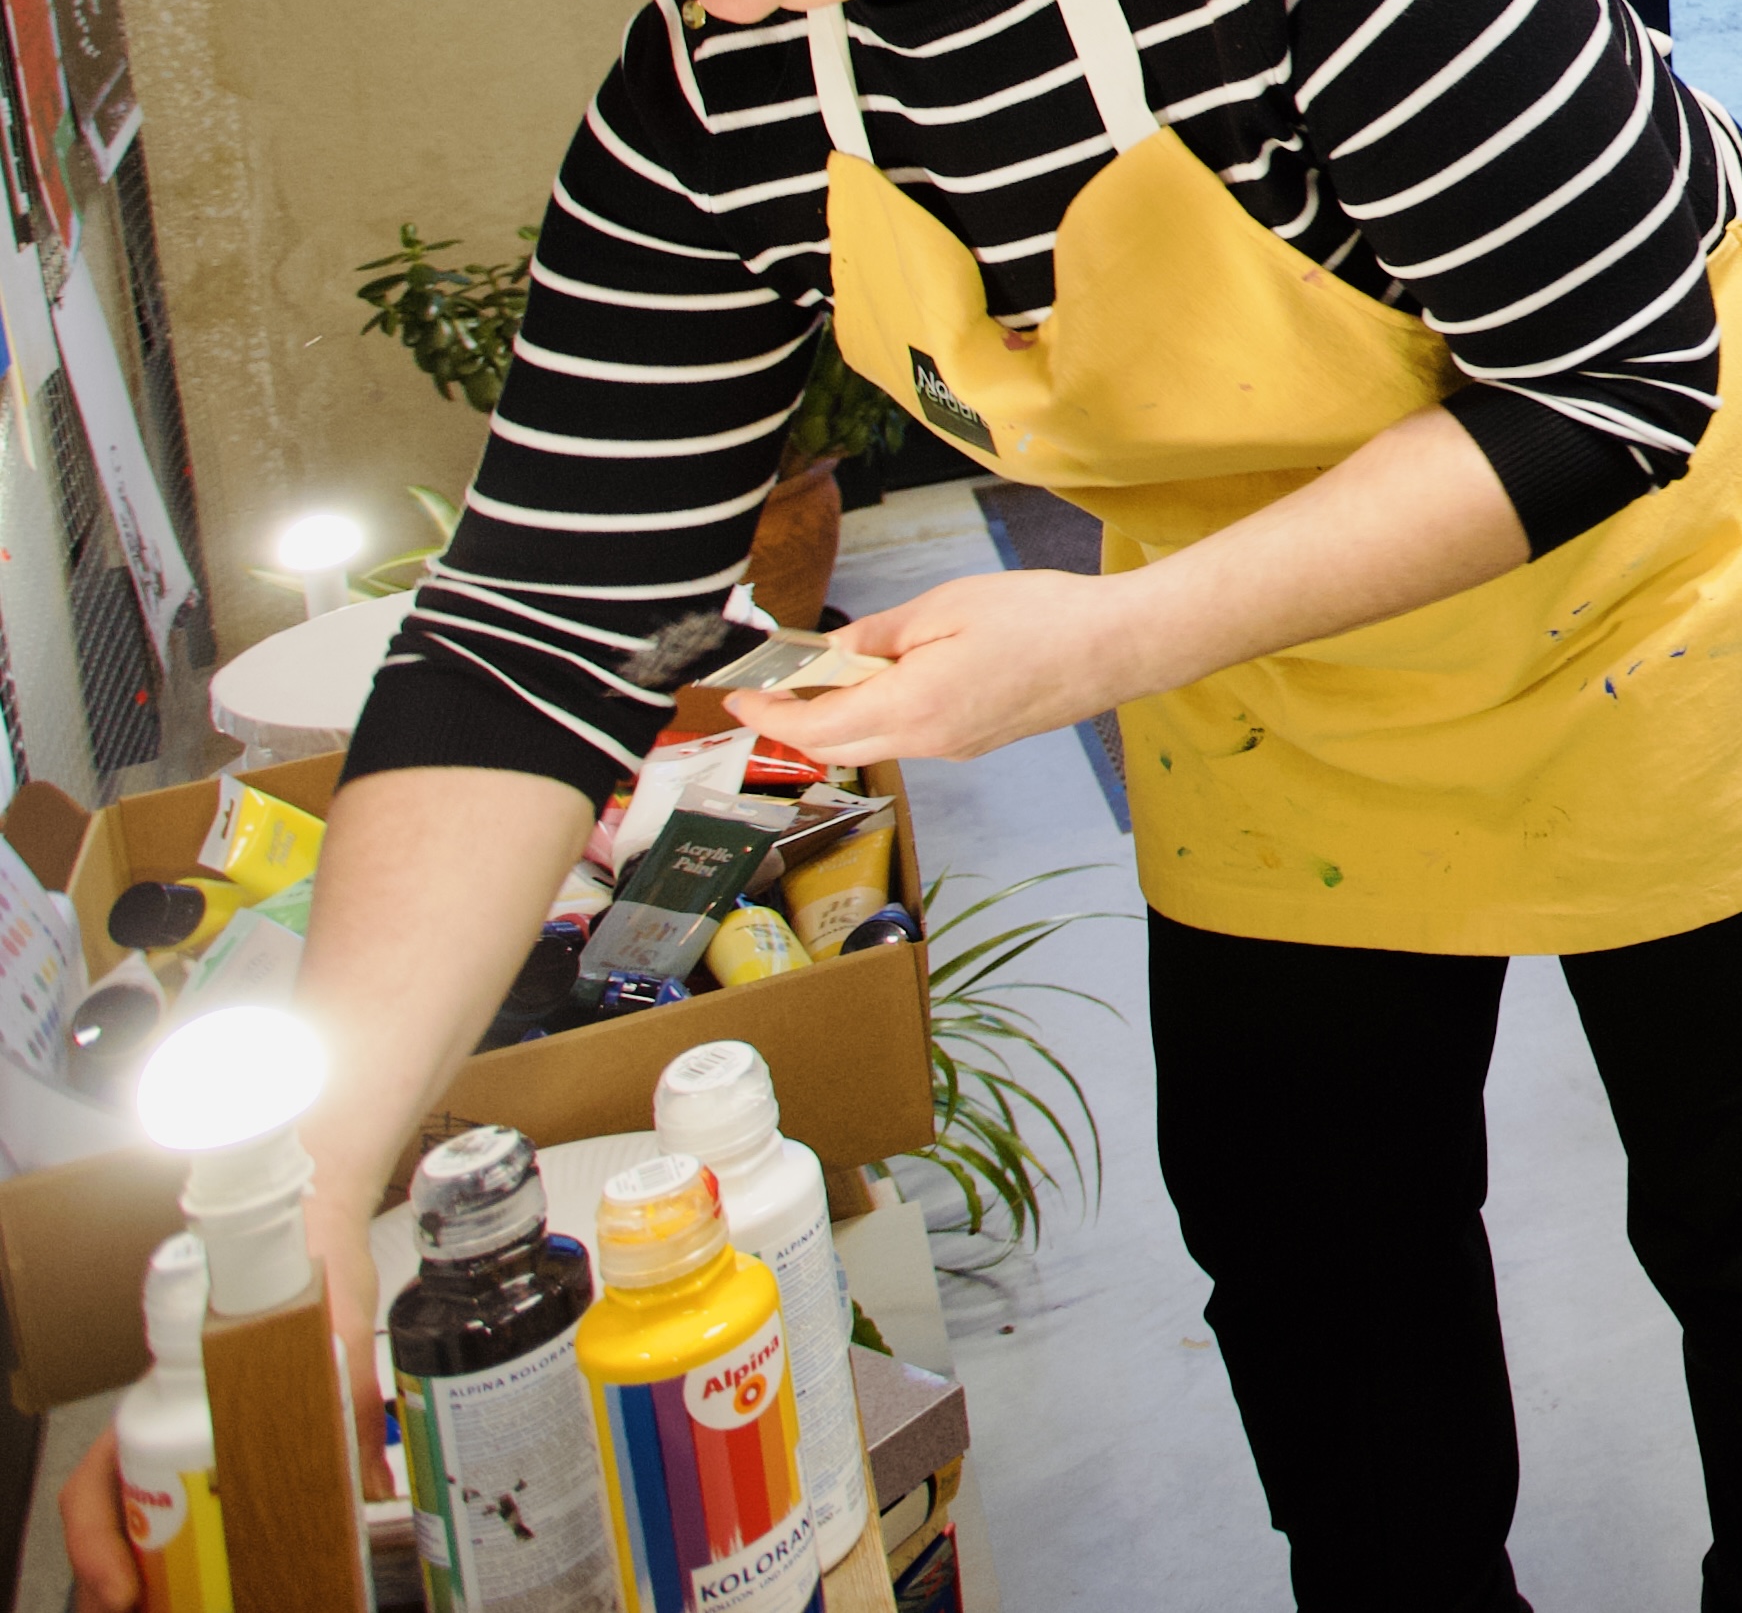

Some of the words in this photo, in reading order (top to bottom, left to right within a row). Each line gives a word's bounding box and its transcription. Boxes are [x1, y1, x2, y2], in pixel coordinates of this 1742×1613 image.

[672, 856, 716, 878] Paint
[674, 841, 733, 864] Acrylic
[776, 1229, 814, 1261] ALPINA
[450, 1377, 504, 1399] ALPINA
[510, 1340, 575, 1383] KOLORAN
[702, 1335, 780, 1400] Alpina
[701, 1509, 811, 1603] KOLORAN
